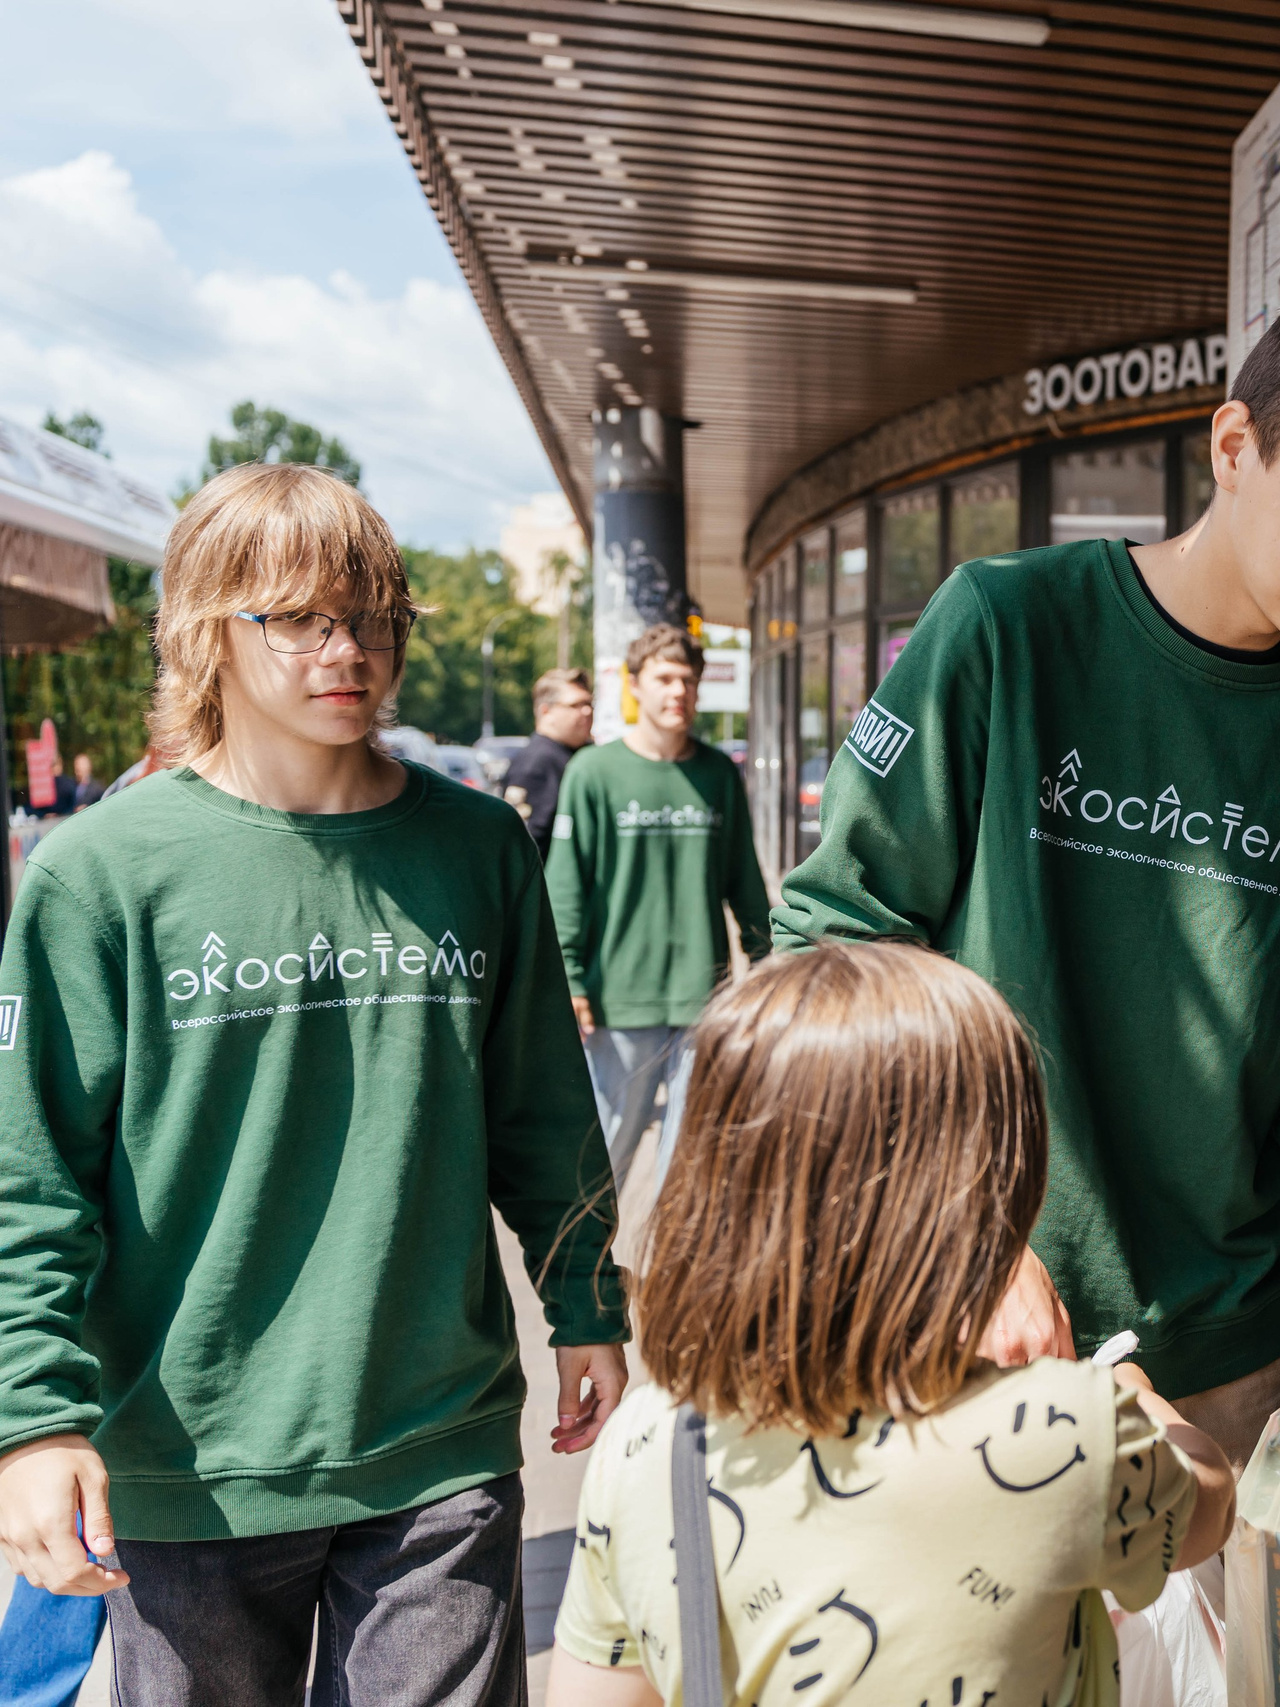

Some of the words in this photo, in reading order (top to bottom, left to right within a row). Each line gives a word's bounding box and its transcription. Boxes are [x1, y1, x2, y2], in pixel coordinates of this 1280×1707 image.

[1022, 334, 1228, 416] ЗООТОВАР
[1029, 827, 1104, 855] Всероссийское
[1105, 848, 1196, 874] экологическое
[1197, 866, 1279, 896] общественное
[171, 1008, 275, 1031] Всероссийское
[276, 995, 362, 1015] экологическое
[363, 993, 447, 1006] общественное
[741, 1578, 782, 1624] FUN!
[957, 1566, 1016, 1611] FUN!
